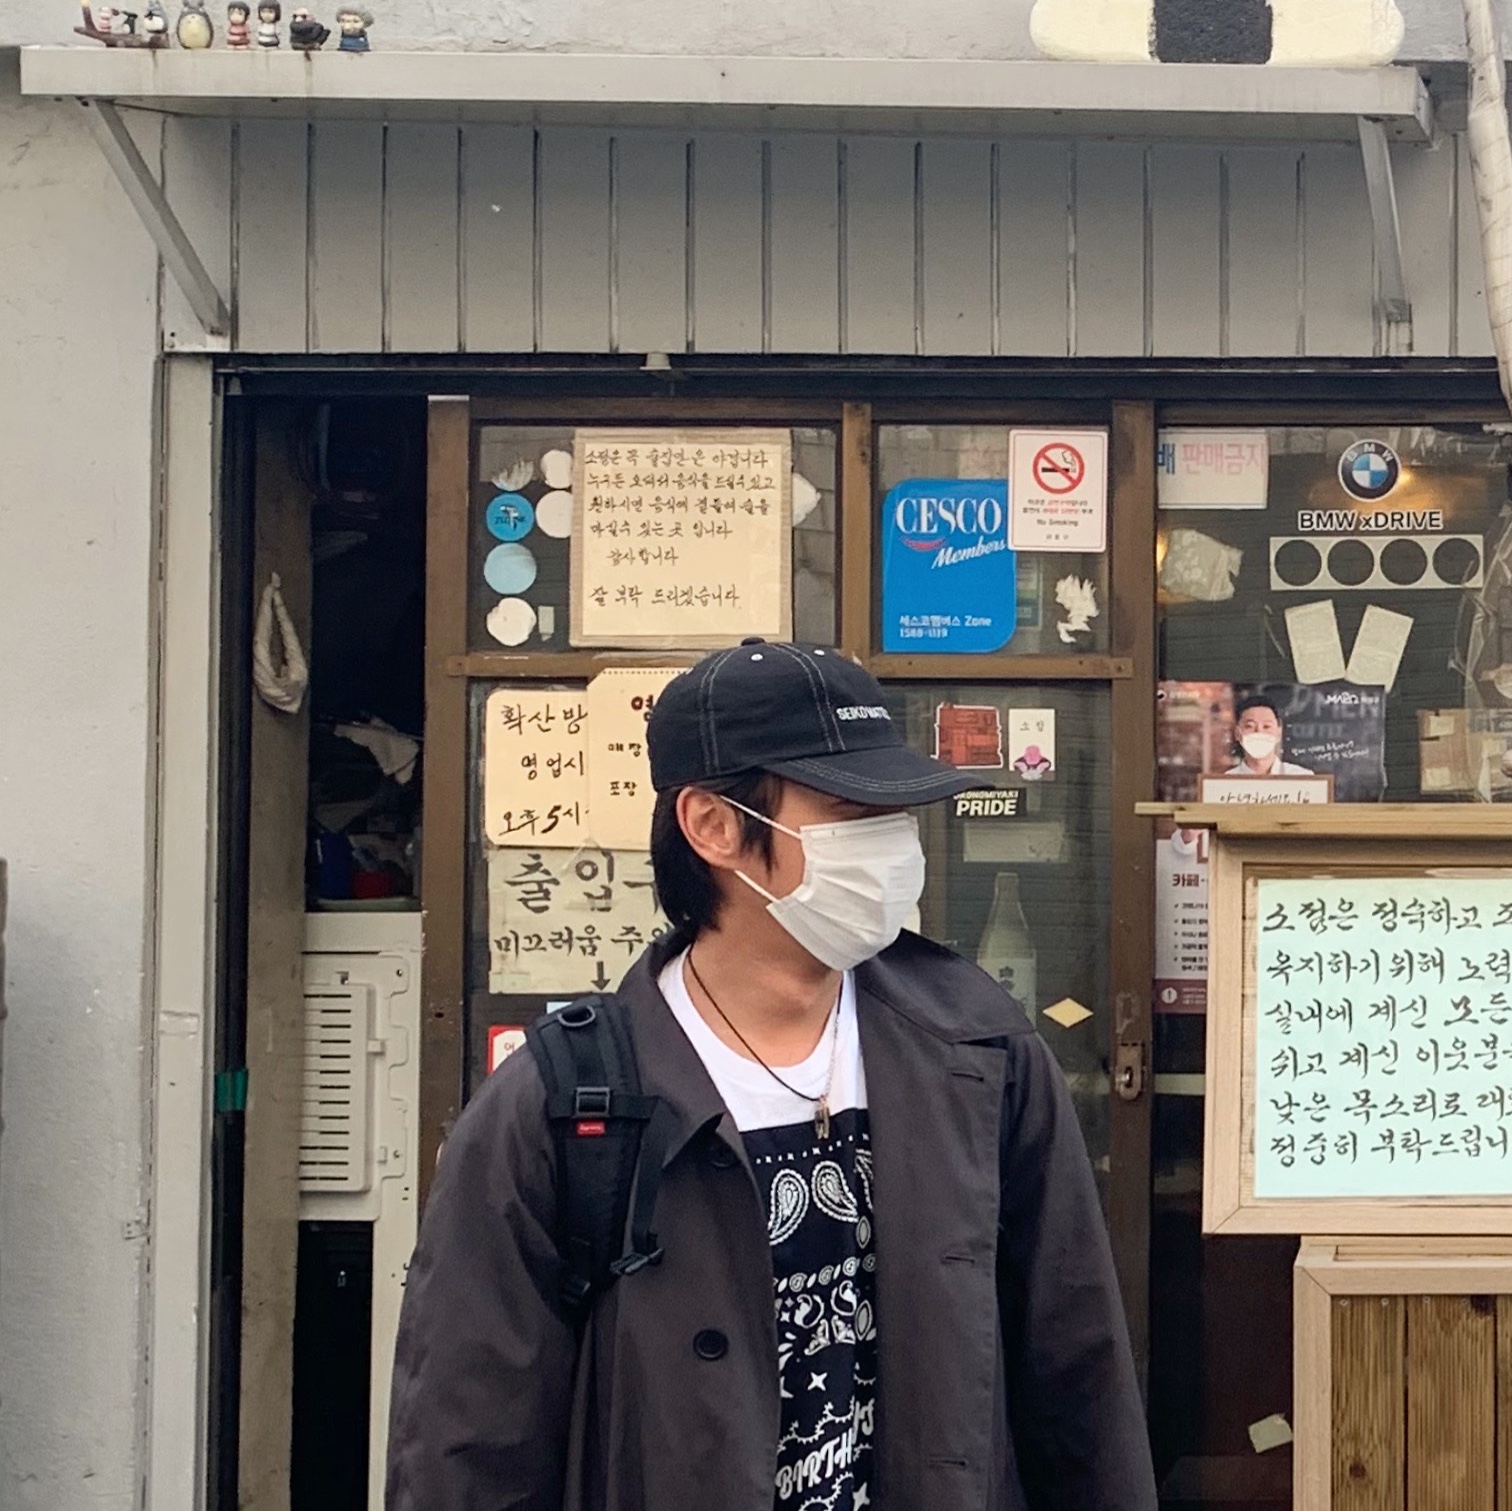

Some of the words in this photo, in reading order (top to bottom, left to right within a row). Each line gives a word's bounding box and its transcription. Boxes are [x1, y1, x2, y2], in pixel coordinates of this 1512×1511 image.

[1182, 442, 1266, 475] 판매금지
[896, 497, 1002, 534] CESCO
[1298, 512, 1355, 531] BMW
[1361, 510, 1443, 530] xDRIVE
[606, 545, 680, 567] 감사합니다
[931, 536, 1006, 569] Members
[965, 615, 992, 627] Zone
[956, 800, 1017, 816] PRIDE
[1371, 894, 1484, 936] 정숙하고
[1266, 949, 1381, 987] 유지하기
[1387, 946, 1446, 987] 위해
[1263, 997, 1354, 1035] 실내에
[1368, 995, 1430, 1032] 계신
[1270, 1046, 1328, 1080] 쉬고
[1337, 1038, 1400, 1080] 계신
[1269, 1092, 1331, 1126] 낮은
[1342, 1086, 1468, 1126] 목소리로
[1269, 1129, 1360, 1168] 정중히
[775, 1428, 854, 1500] BIRTH
